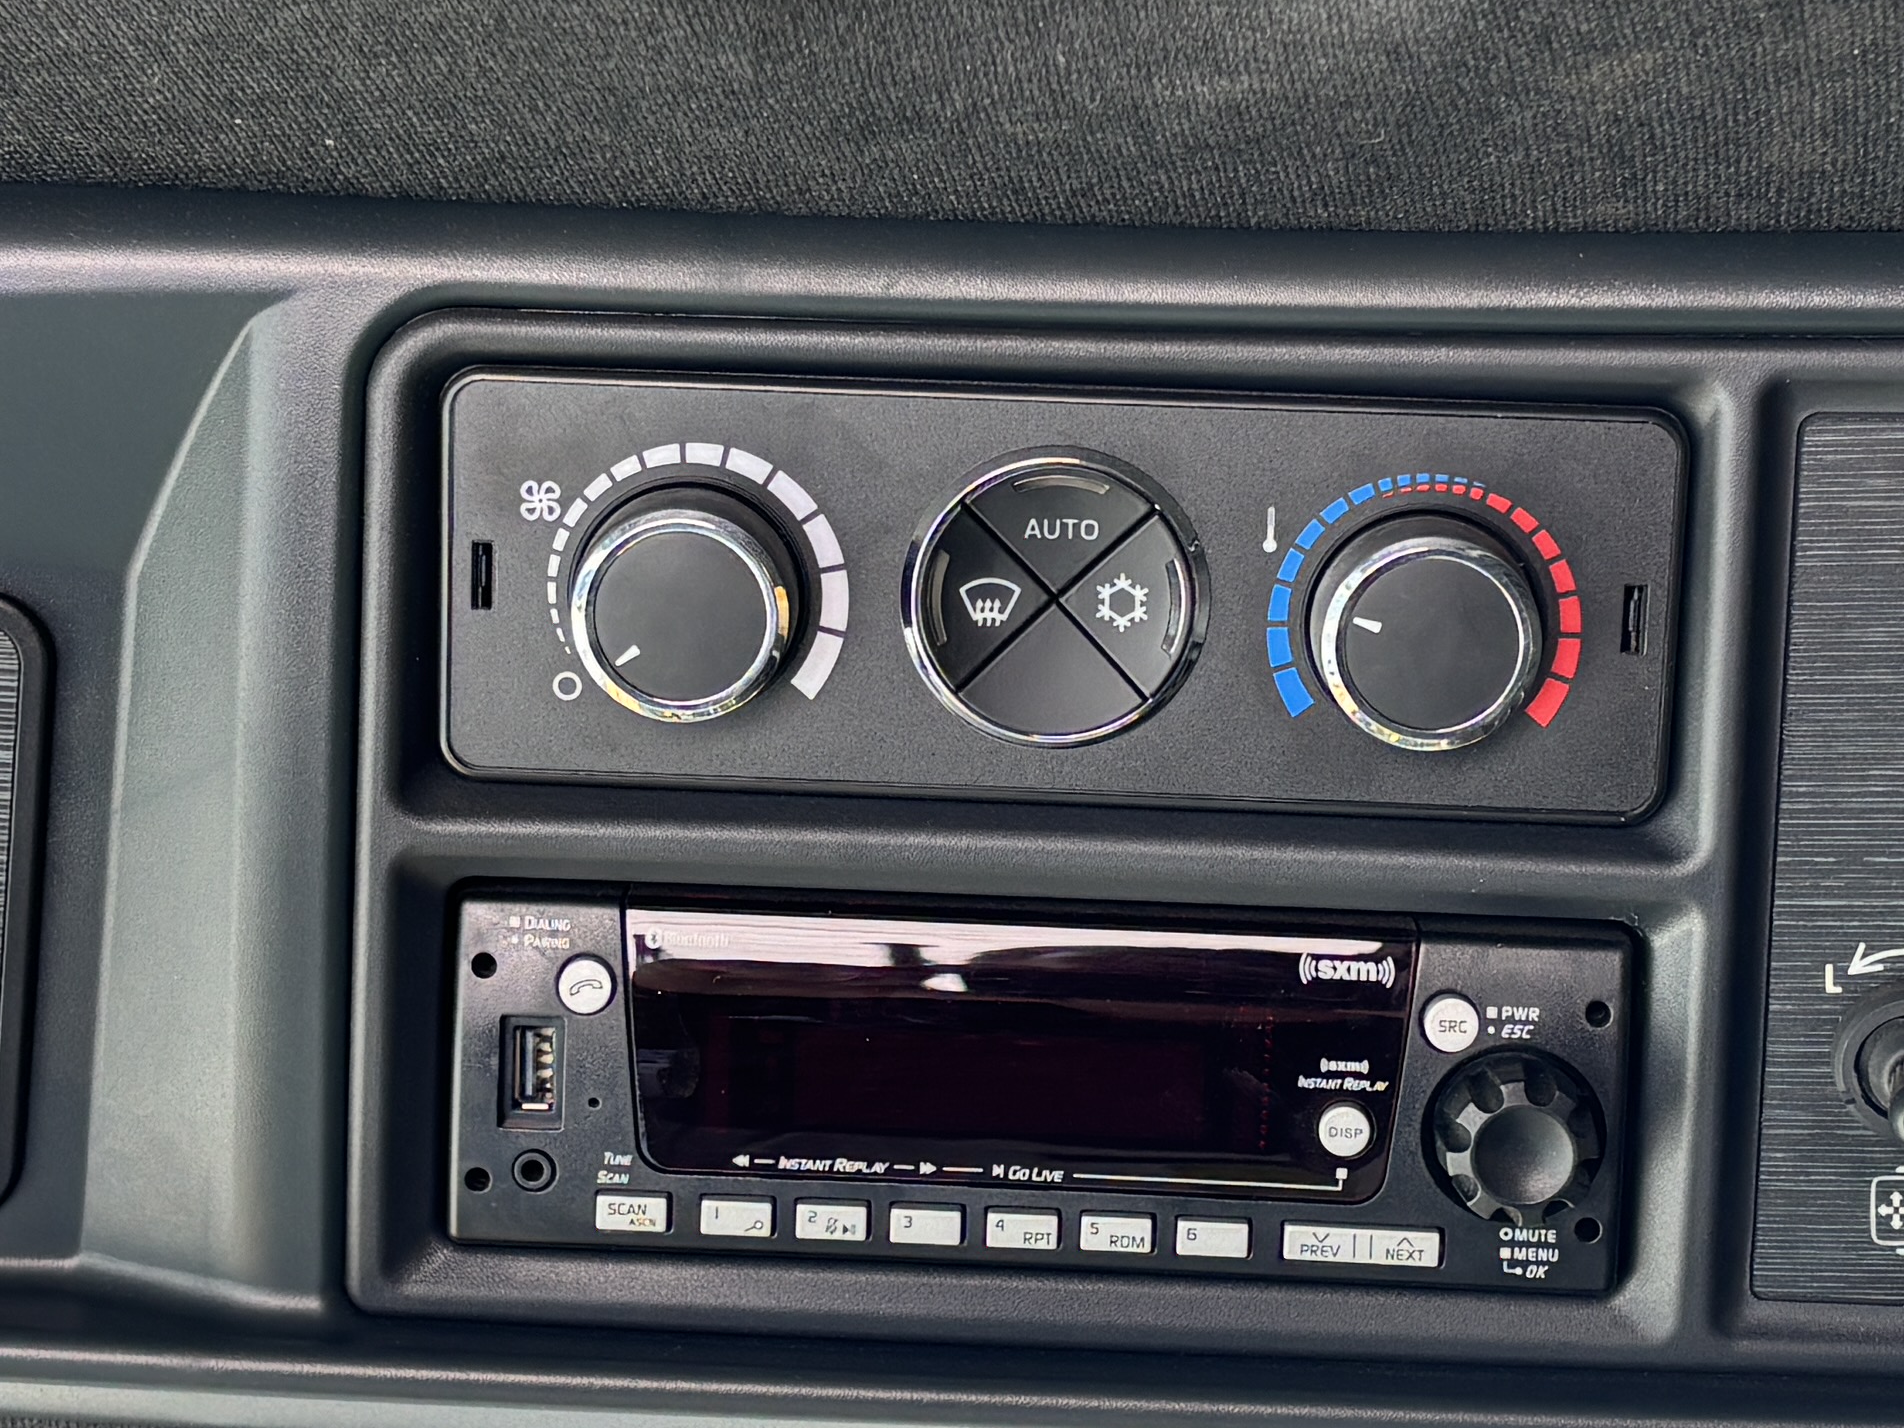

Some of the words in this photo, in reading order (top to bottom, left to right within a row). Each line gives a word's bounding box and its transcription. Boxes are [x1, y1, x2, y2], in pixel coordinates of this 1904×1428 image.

[1024, 518, 1099, 541] AUTO
[524, 915, 571, 932] DIALING
[1825, 963, 1843, 994] L
[1501, 1005, 1540, 1022] PWR
[1438, 1019, 1468, 1034] SRC
[1500, 1023, 1535, 1039] ESC
[1297, 1075, 1342, 1090] INSTANT
[1342, 1076, 1390, 1092] REPLAY
[1328, 1126, 1364, 1139] DISP
[603, 1151, 634, 1167] TUNE
[777, 1155, 833, 1172] INSTANT
[833, 1157, 891, 1174] REPLAY
[597, 1169, 630, 1184] SCAN
[1031, 1167, 1065, 1183] LIVE
[607, 1202, 648, 1216] SCAN
[807, 1210, 818, 1223] 2
[902, 1215, 914, 1229] 3
[994, 1218, 1005, 1232] 4
[1089, 1222, 1100, 1236] 5
[1022, 1231, 1053, 1246] RPT
[1109, 1234, 1146, 1249] RDM
[1186, 1227, 1197, 1241] 6
[1514, 1227, 1557, 1243] MUTE
[1299, 1243, 1341, 1258] PREV
[1385, 1248, 1425, 1262] NEXT
[1514, 1247, 1560, 1263] MENU
[1525, 1264, 1550, 1279] OK
